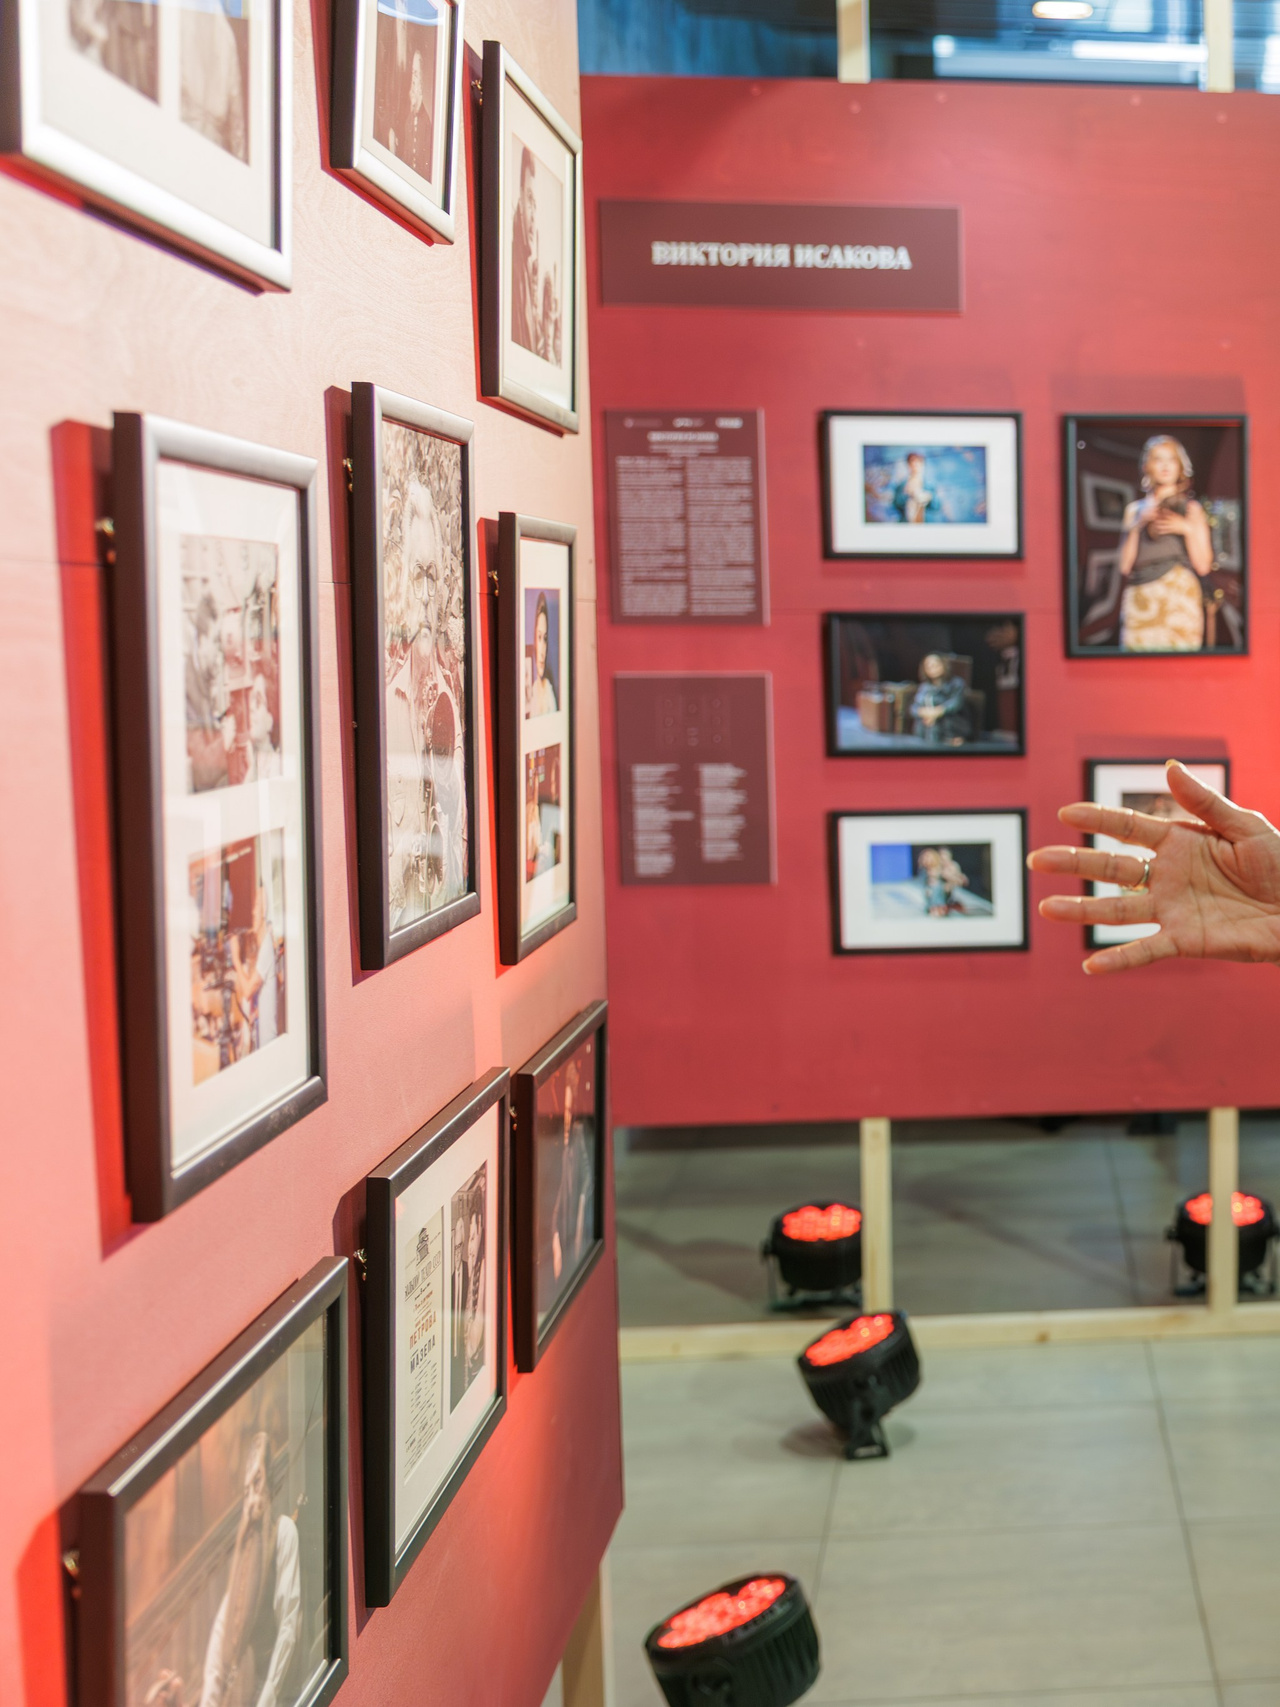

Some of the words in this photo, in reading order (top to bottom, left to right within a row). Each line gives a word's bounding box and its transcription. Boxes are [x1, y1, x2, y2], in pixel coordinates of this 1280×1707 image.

[651, 241, 790, 268] ВИКТОРИЯ
[794, 244, 912, 270] ИСАКОВА
[409, 1310, 437, 1350] ПЕТРОВА
[410, 1334, 436, 1374] МАЗЕПА
